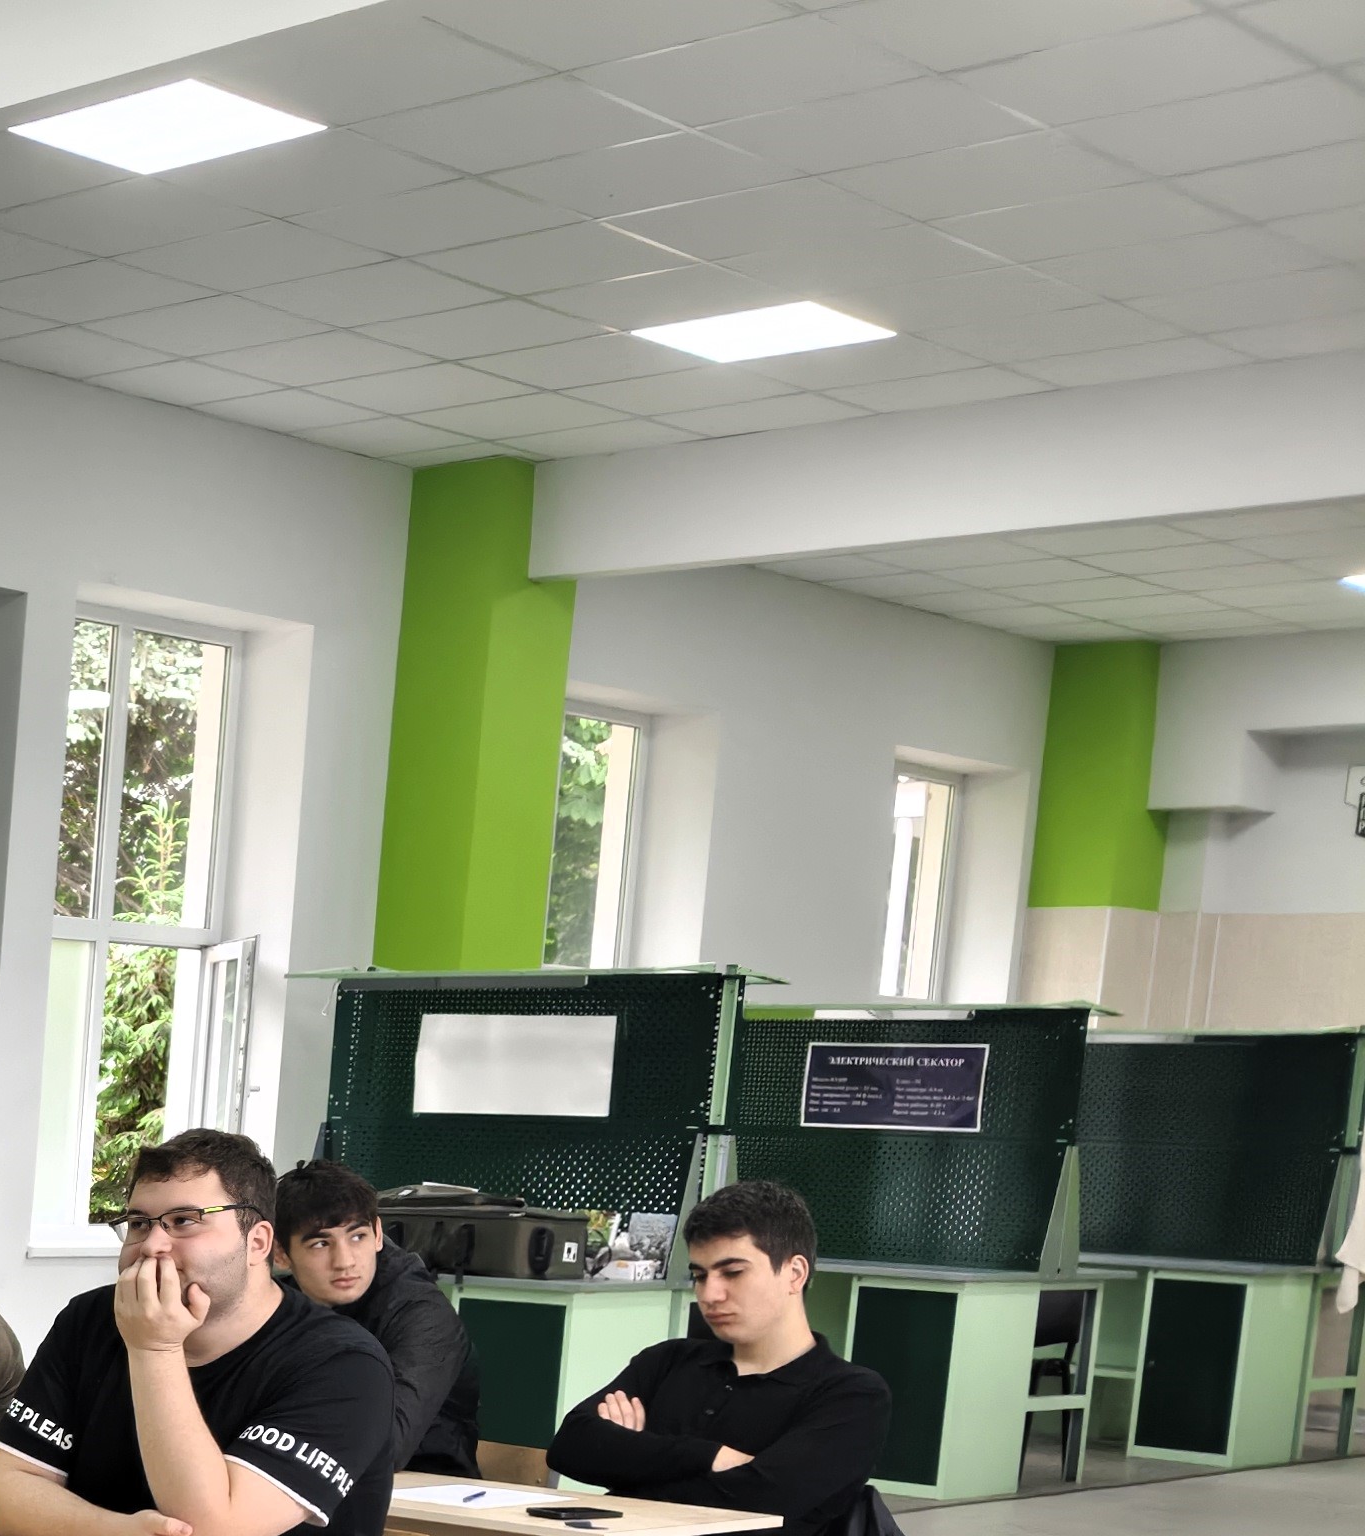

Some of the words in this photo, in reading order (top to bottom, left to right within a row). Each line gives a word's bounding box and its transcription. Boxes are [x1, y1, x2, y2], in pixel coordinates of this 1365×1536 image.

[828, 1056, 914, 1066] ЭЛЕКТРИЧЕСКИЙ
[916, 1058, 965, 1068] СЕКАТОР
[18, 1406, 73, 1450] PLEAS
[238, 1424, 296, 1452] GOOD
[296, 1442, 338, 1478] LIFE
